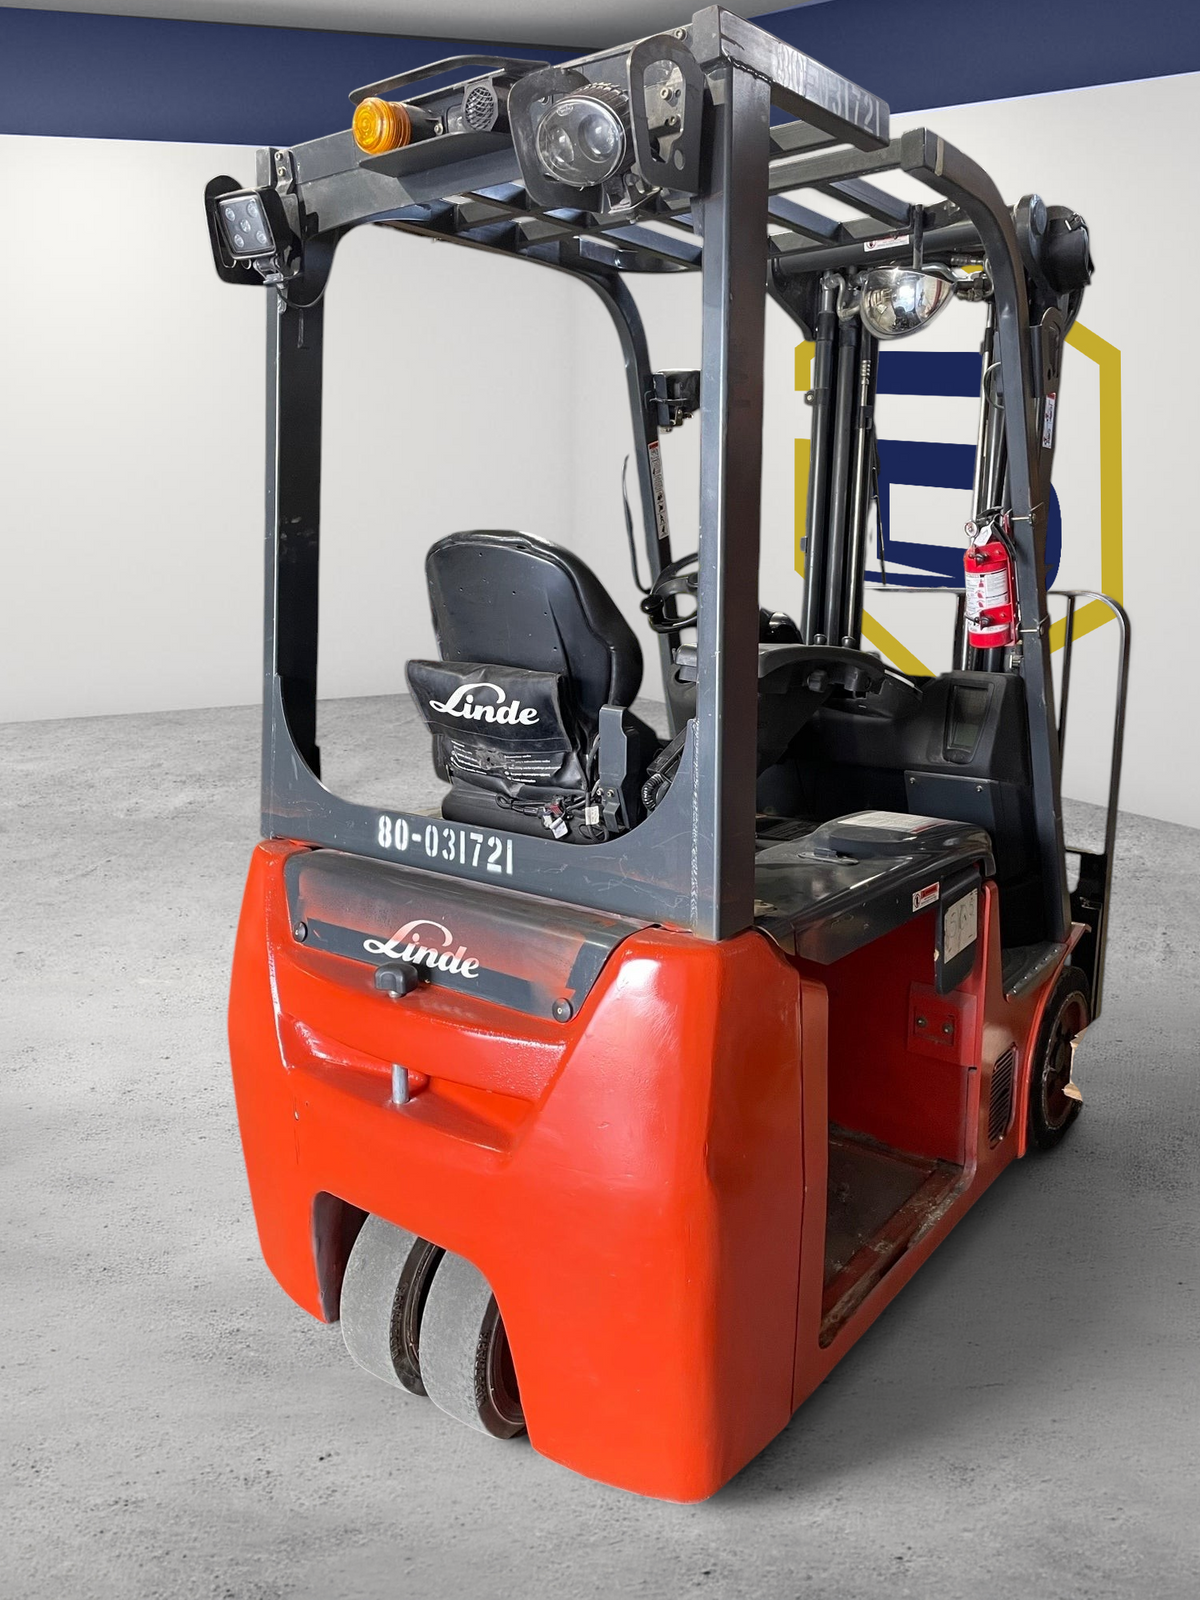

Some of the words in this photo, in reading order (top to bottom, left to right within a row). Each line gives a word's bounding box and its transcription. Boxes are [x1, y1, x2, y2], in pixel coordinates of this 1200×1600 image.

[429, 682, 540, 726] Linde
[378, 815, 513, 875] 80-031721
[363, 919, 480, 979] Linde
